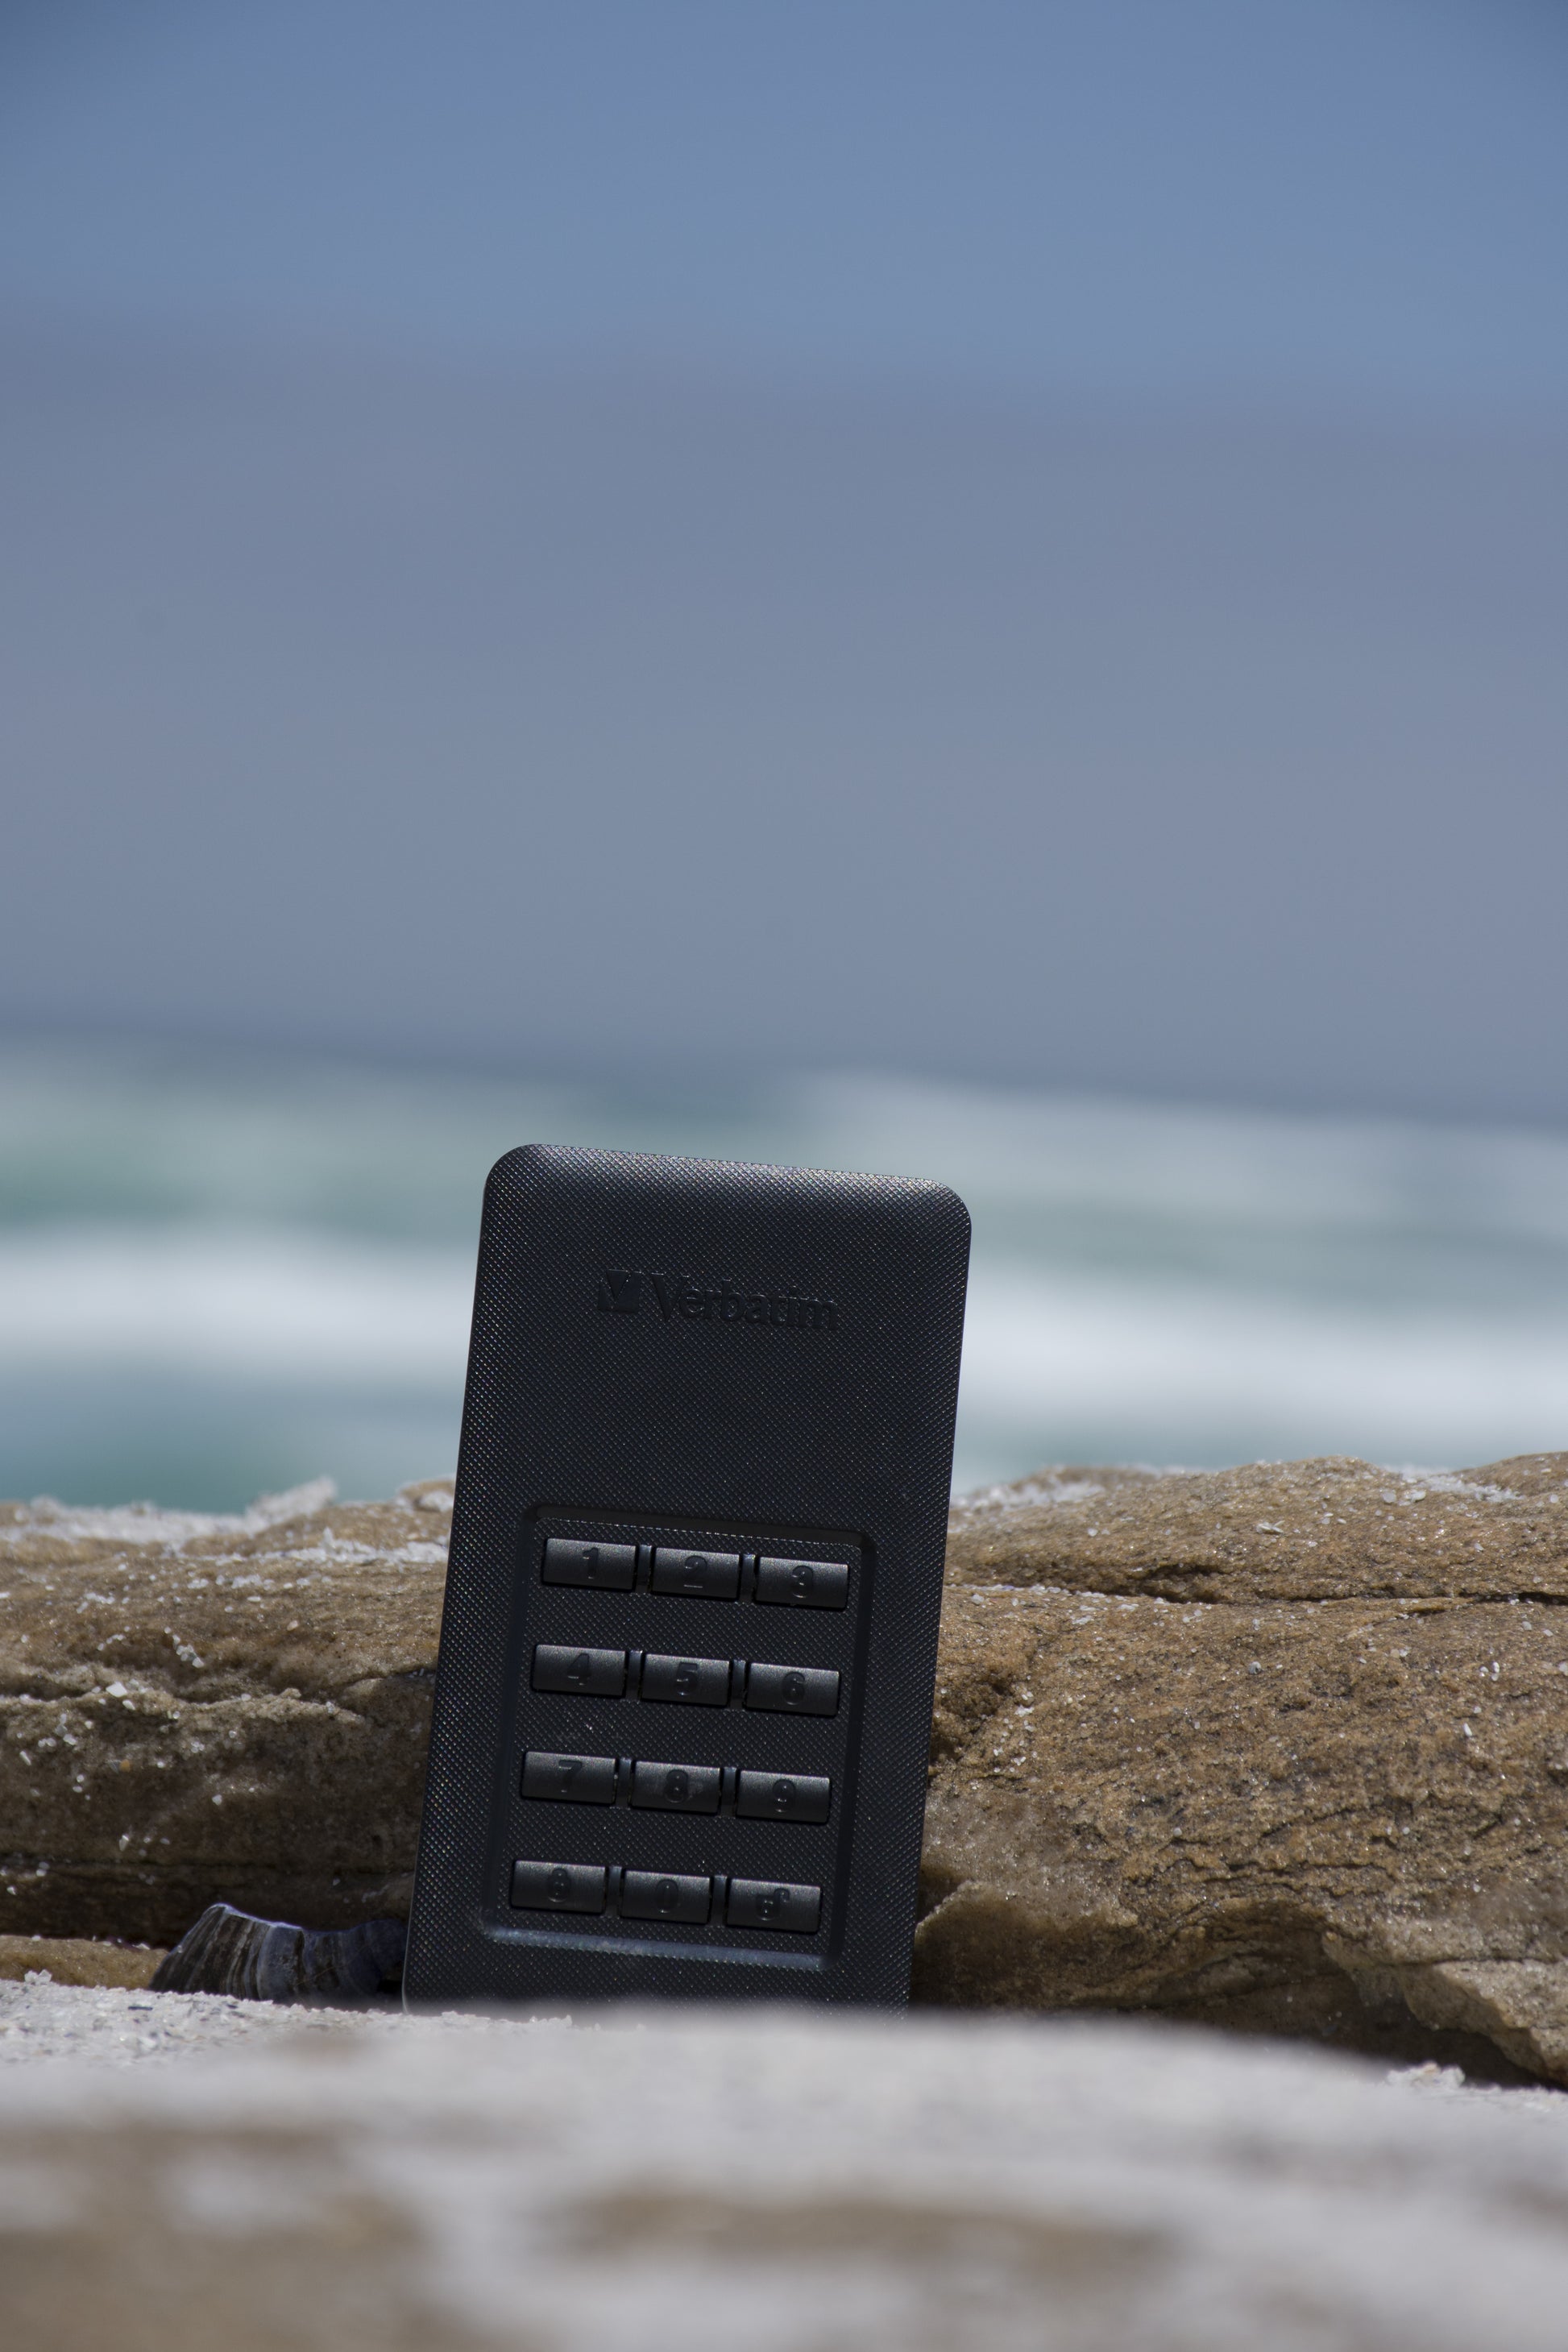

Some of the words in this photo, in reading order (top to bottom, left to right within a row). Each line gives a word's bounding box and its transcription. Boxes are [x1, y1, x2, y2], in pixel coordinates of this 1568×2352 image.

[650, 1271, 837, 1329] Verbatim
[583, 1546, 599, 1580] 1
[683, 1555, 708, 1588] 2
[790, 1565, 815, 1599] 3
[566, 1653, 591, 1686] 4
[676, 1661, 699, 1696] 5
[782, 1671, 806, 1706] 6
[558, 1759, 583, 1793] 7
[665, 1769, 689, 1803] 8
[772, 1779, 796, 1814] 9
[655, 1878, 679, 1914] 0
